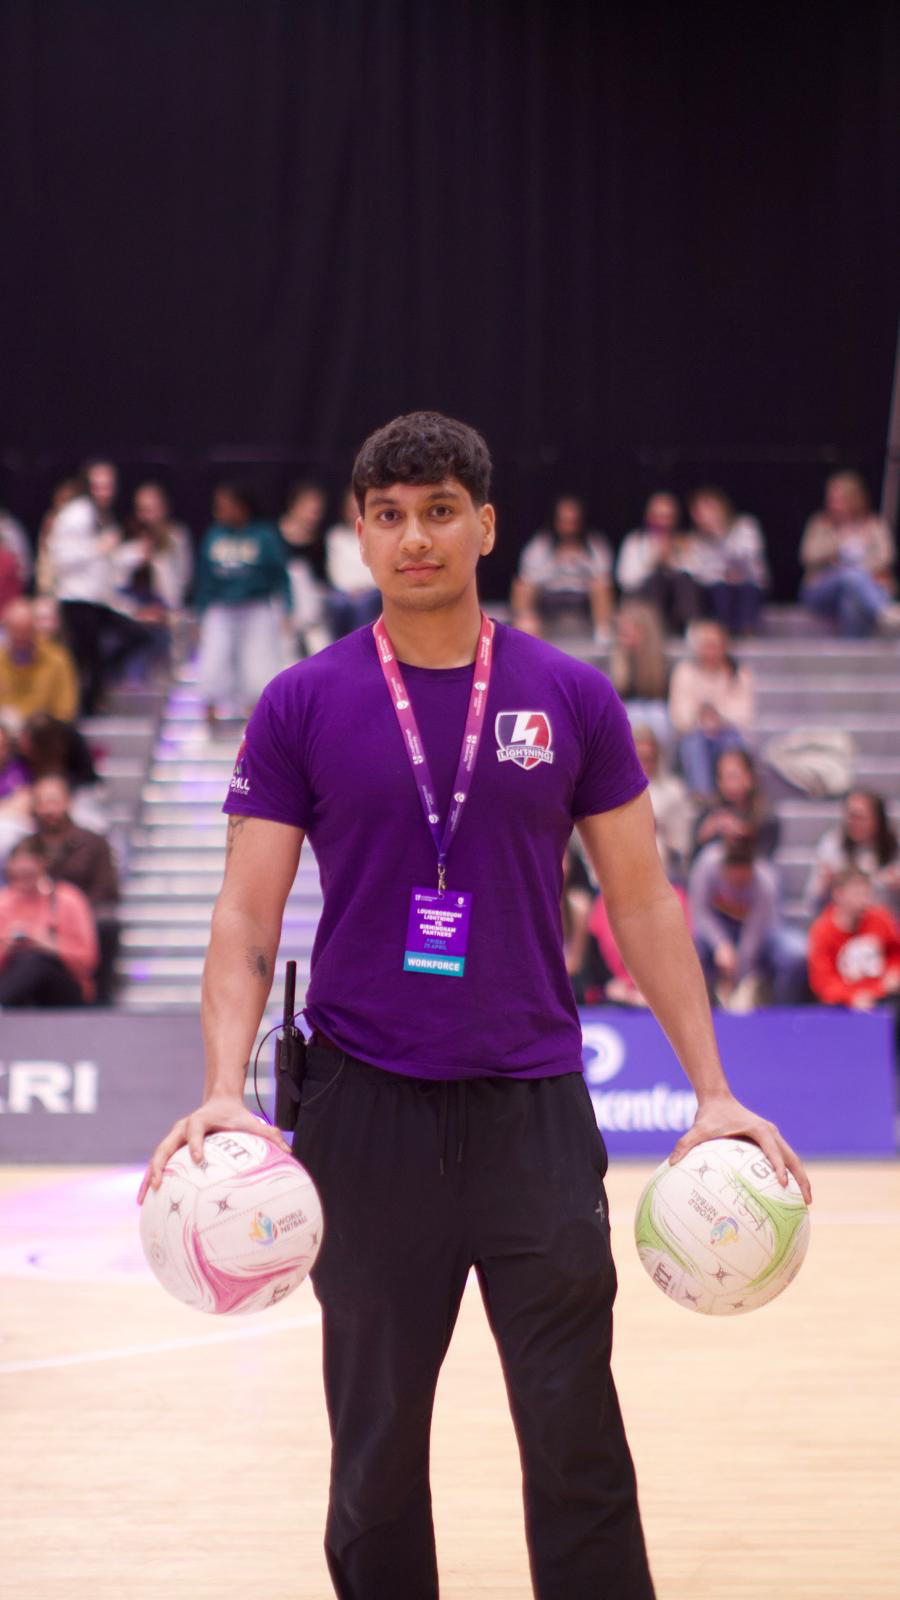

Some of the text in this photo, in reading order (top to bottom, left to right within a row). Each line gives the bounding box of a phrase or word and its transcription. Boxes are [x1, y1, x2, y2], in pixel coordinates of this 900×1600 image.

[499, 748, 552, 762] LIGHTNING
[417, 908, 462, 918] LOUGHBOROUGH
[424, 914, 455, 923] LIGHTNING
[419, 923, 456, 933] BIRMINGHAM
[422, 929, 452, 938] PANTHERS
[407, 957, 460, 972] WORKFORCE
[0, 1060, 98, 1114] RI
[277, 1208, 303, 1227] WORLD
